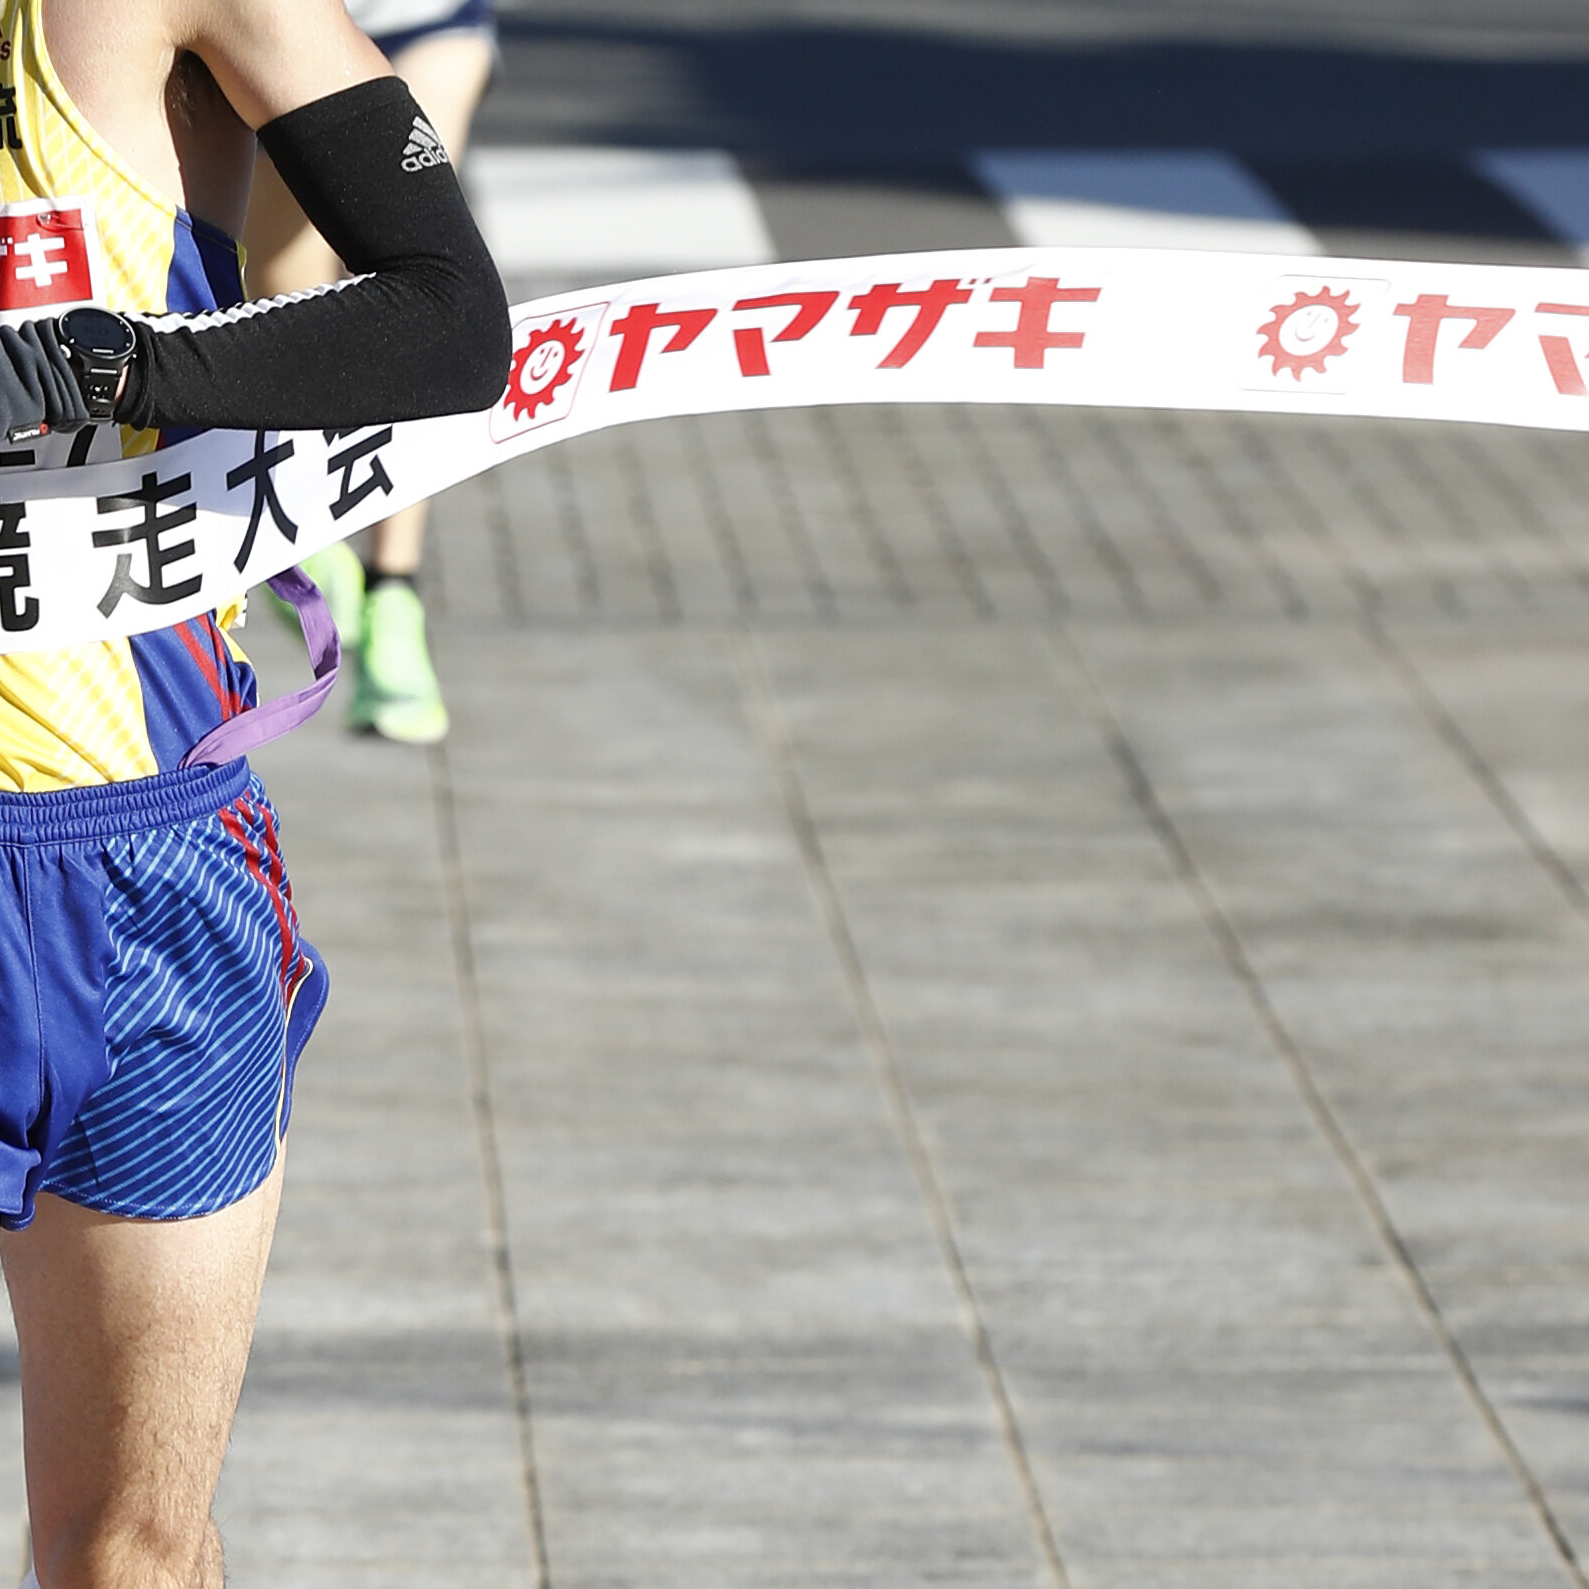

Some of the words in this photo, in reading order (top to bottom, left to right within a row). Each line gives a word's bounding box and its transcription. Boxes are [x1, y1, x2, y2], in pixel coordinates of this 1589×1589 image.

[401, 145, 450, 172] adid
[608, 276, 1103, 393] ヤマザキ
